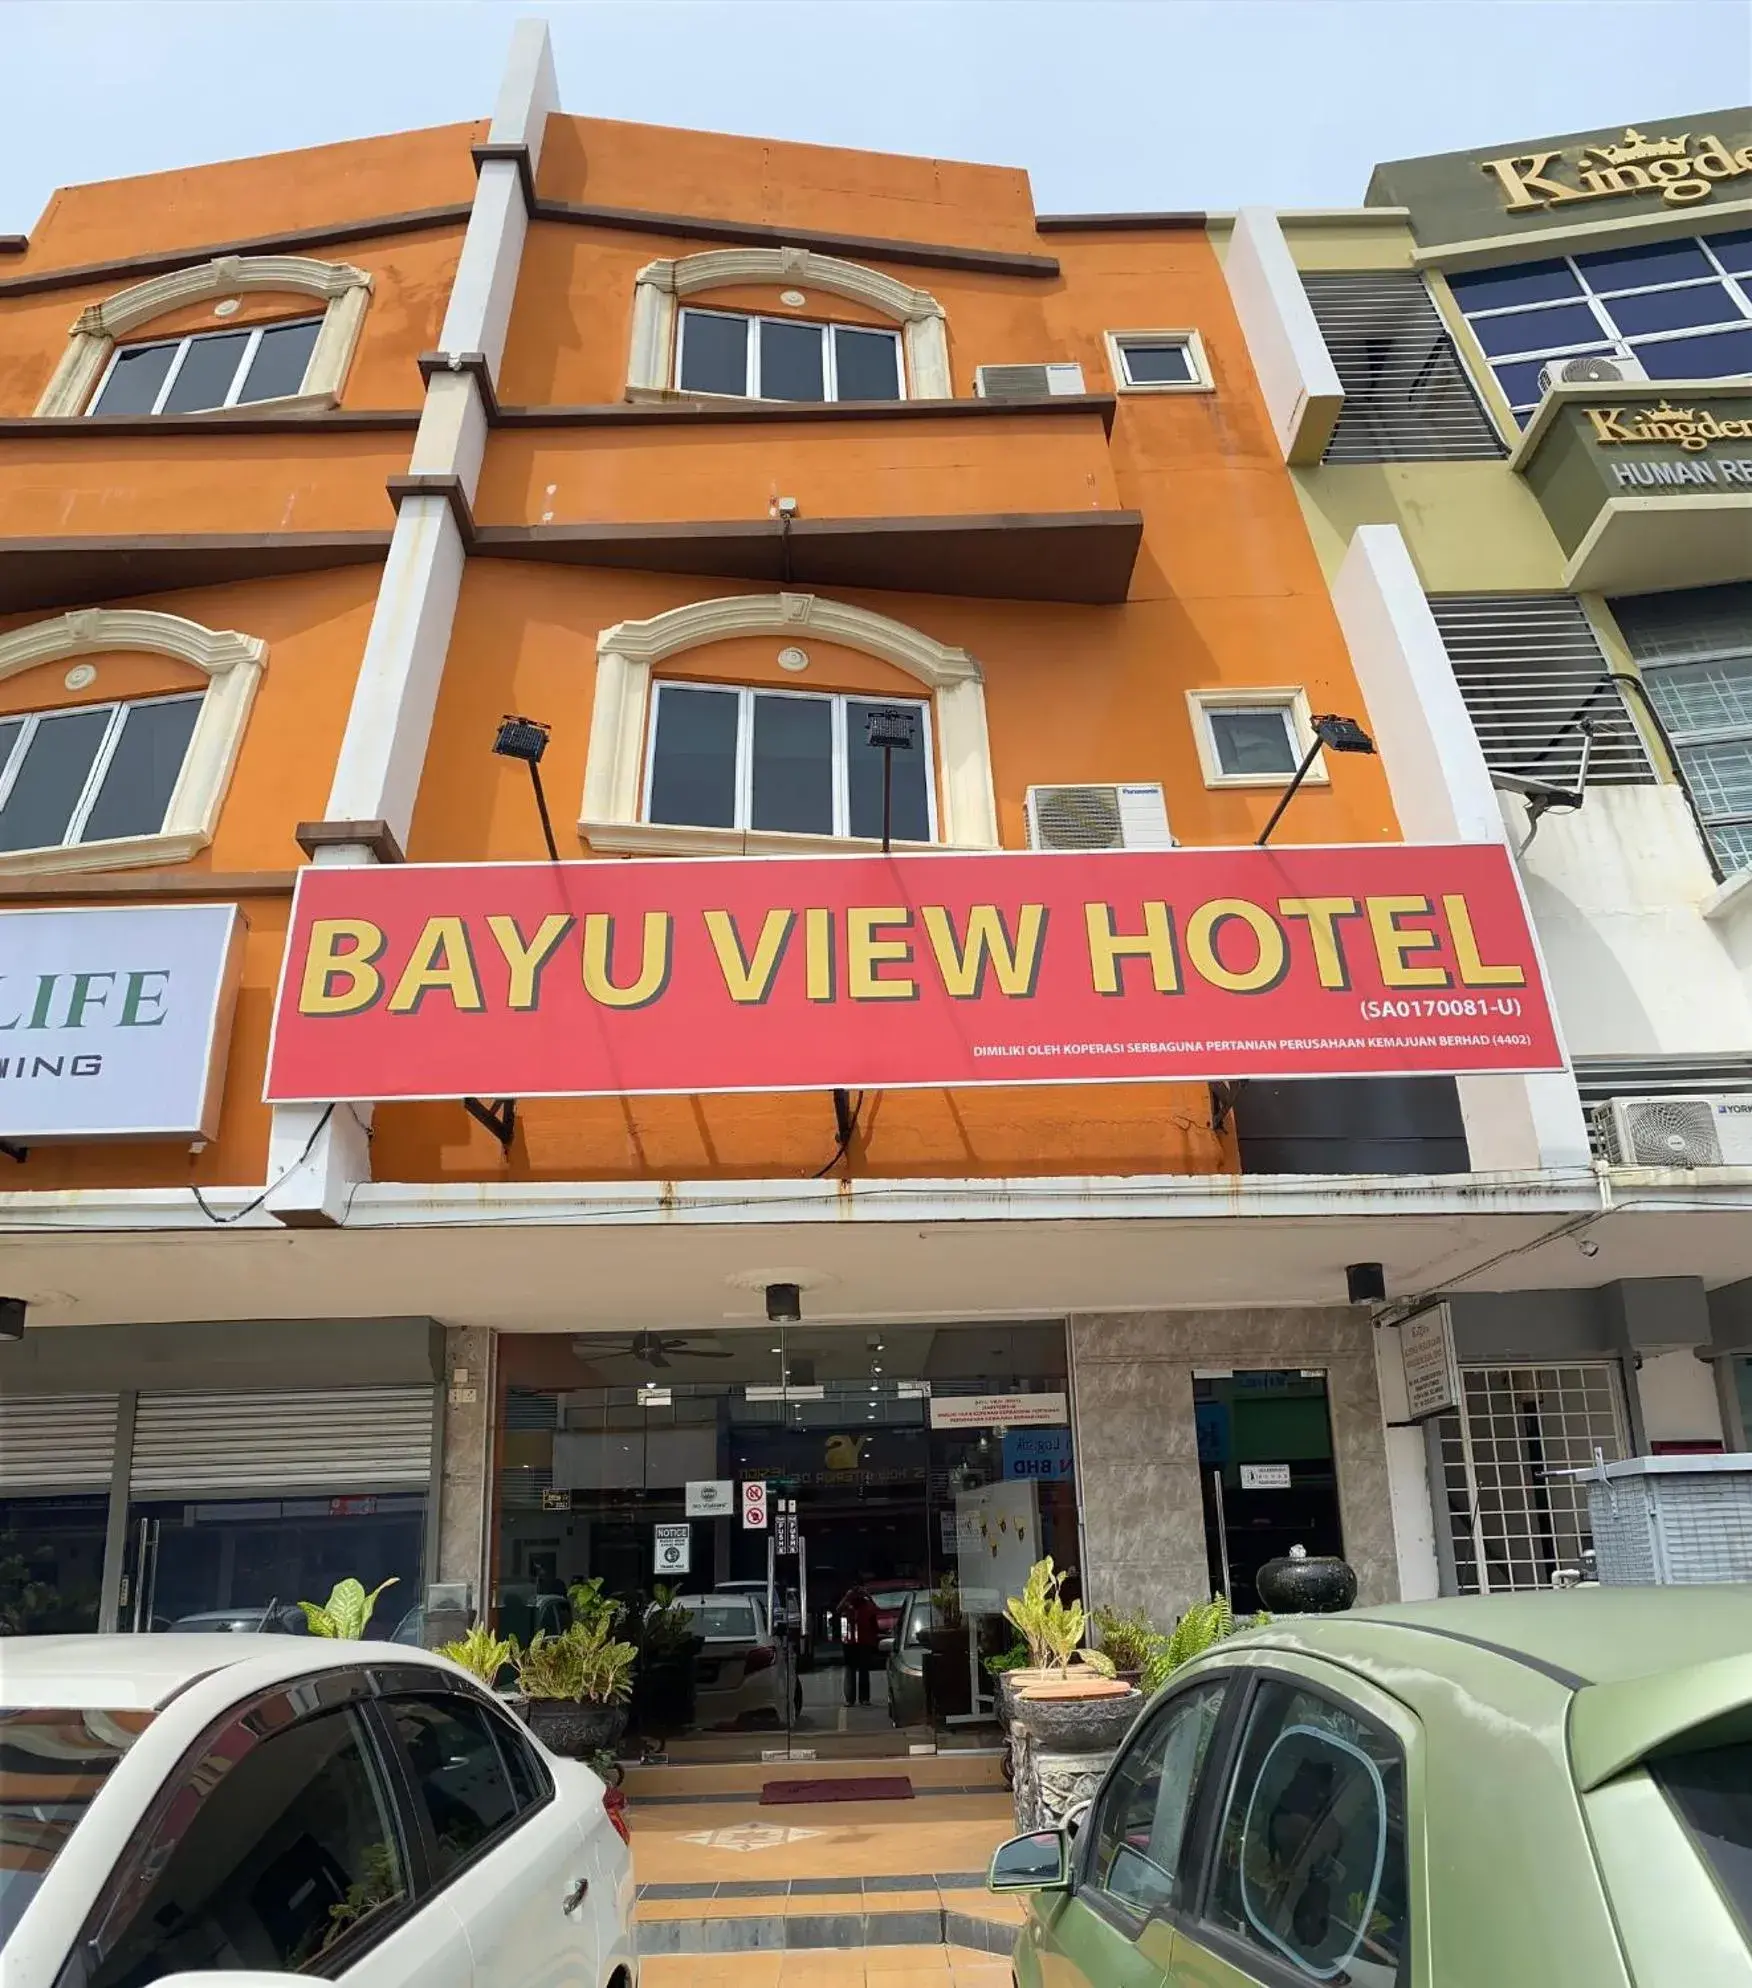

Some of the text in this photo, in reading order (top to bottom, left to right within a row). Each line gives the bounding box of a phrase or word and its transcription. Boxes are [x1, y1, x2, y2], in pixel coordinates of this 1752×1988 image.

[1611, 460, 1717, 486] HUMAN
[297, 894, 1527, 1017] BAYU VIEW HOTEL
[1360, 998, 1521, 1021] (SA0170081-U)
[973, 1033, 1531, 1057] DIMILIKI OLEH KOPERASI SERBAGUNA PERTANIAN PERUSAHAAN KEMAJUAN BERHAD (4402)
[657, 1528, 688, 1538] NOTICE
